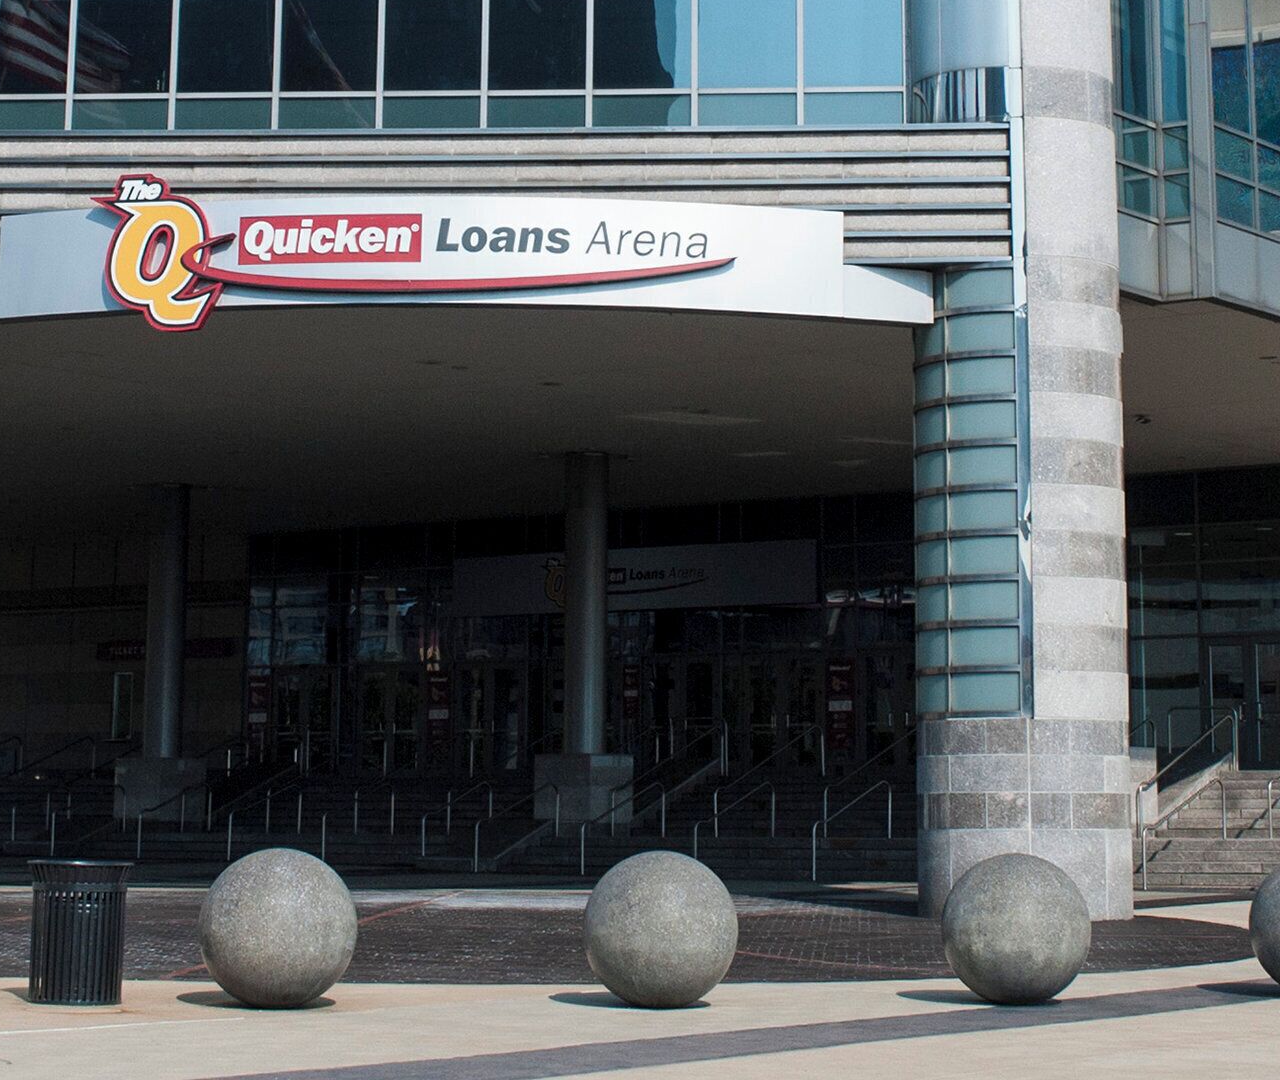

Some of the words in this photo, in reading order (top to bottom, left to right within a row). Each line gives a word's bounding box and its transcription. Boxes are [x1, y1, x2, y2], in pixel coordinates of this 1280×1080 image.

[120, 178, 162, 201] The
[243, 217, 414, 262] Quicken
[435, 218, 570, 255] Loans
[584, 219, 708, 259] Arena
[111, 200, 212, 326] Q
